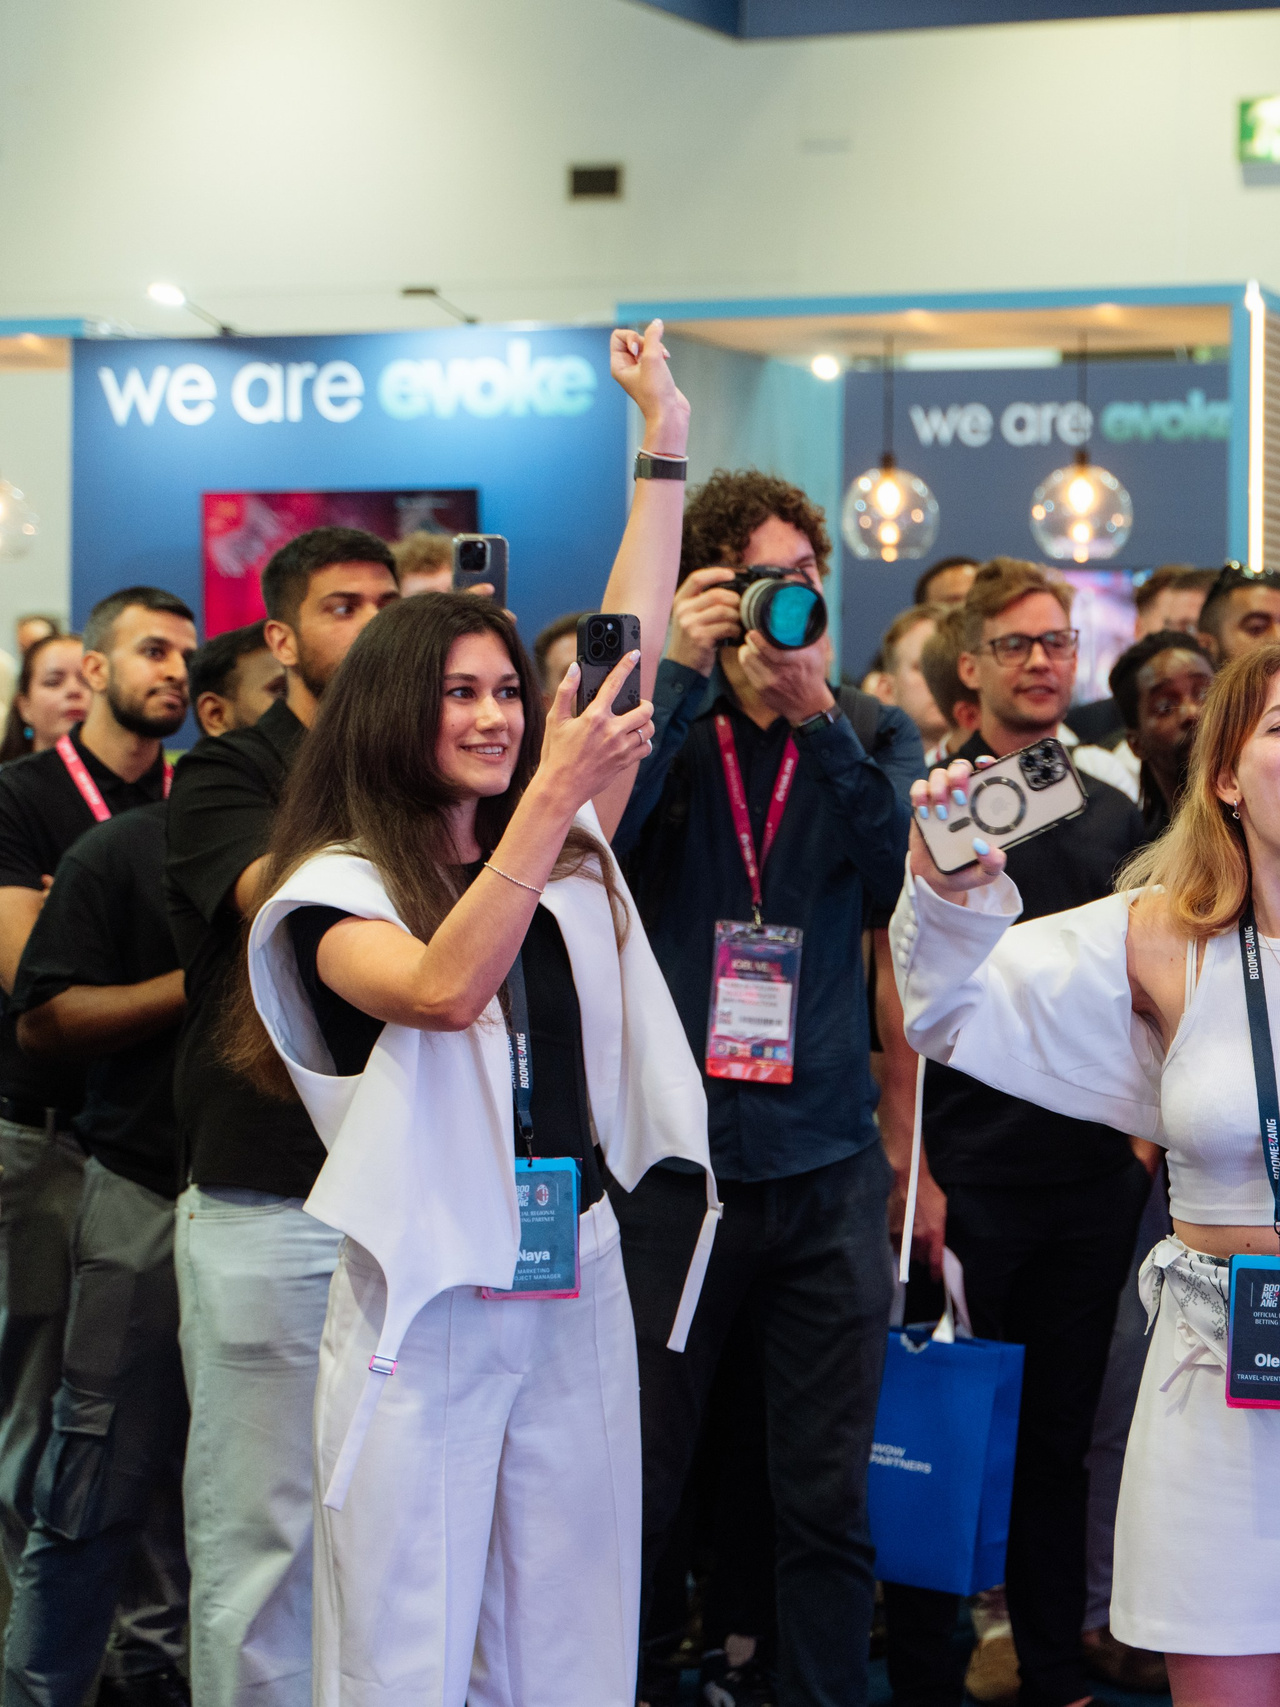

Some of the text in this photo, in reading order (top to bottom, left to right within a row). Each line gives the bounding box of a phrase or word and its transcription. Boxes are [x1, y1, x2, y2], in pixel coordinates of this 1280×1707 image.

[99, 338, 598, 426] we are evoke
[908, 402, 994, 448] we
[1000, 400, 1094, 447] are
[518, 1249, 551, 1264] Naya
[1263, 1283, 1280, 1292] BOO
[1260, 1299, 1278, 1308] ANG
[1253, 1311, 1278, 1319] OFFICIAL
